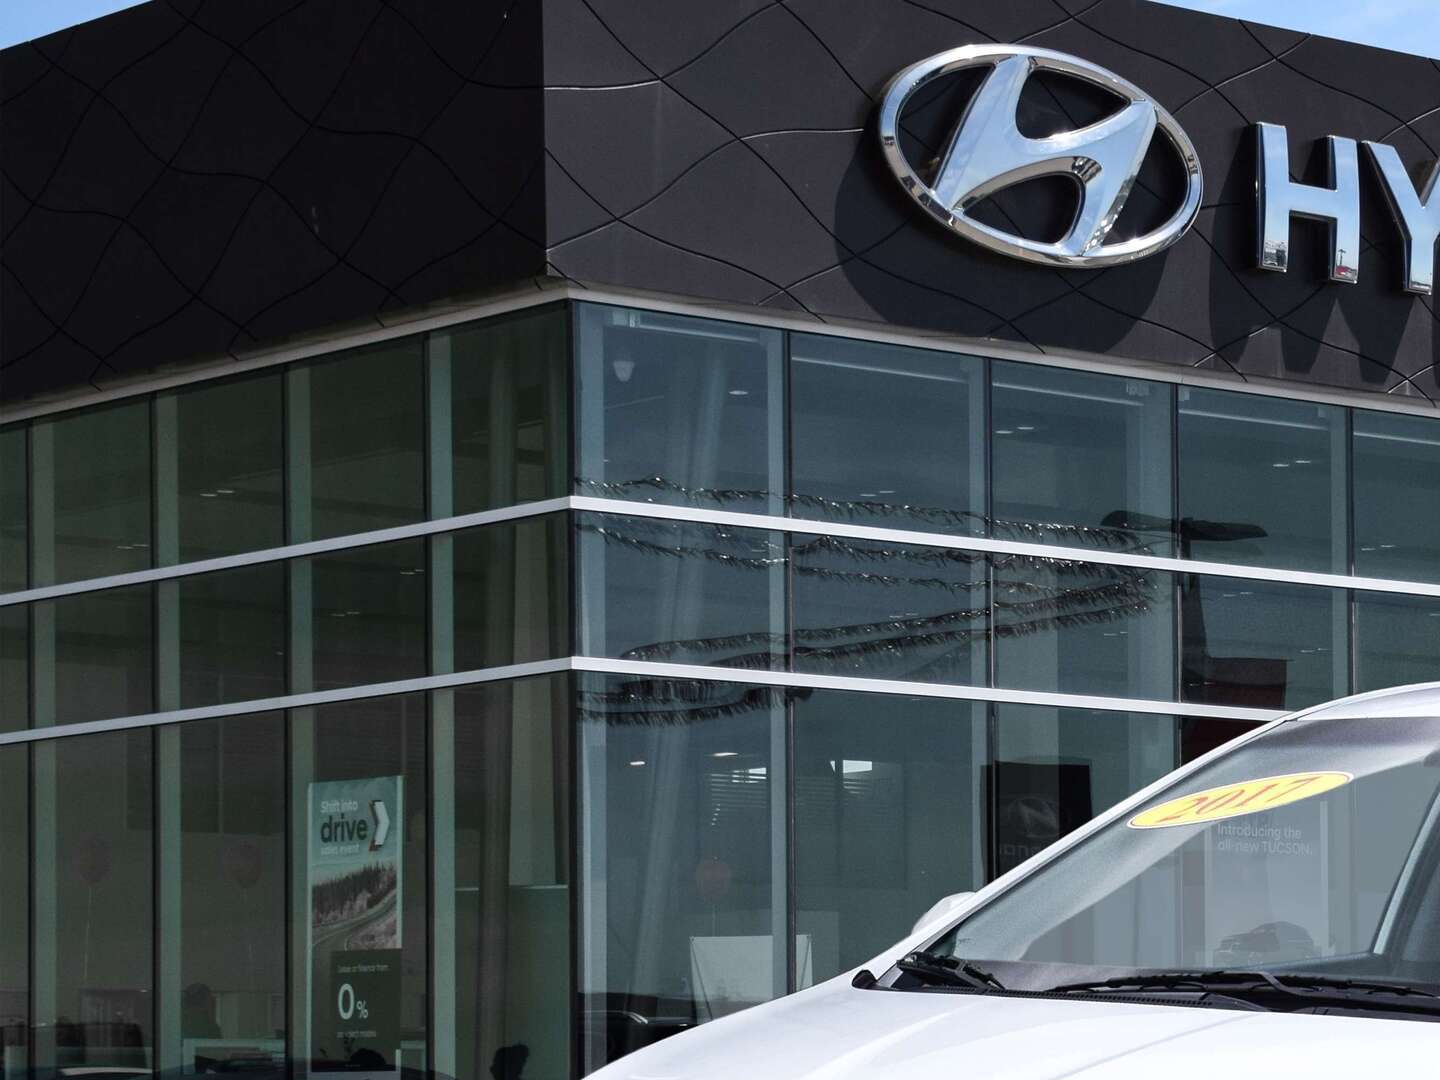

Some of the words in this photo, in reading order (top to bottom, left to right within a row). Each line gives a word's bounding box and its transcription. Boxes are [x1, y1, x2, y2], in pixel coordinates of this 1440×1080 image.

[1155, 775, 1323, 824] 2017
[320, 813, 368, 843] drive
[1217, 823, 1282, 841] Introducing
[1284, 824, 1302, 839] the
[1217, 839, 1259, 853] all-new
